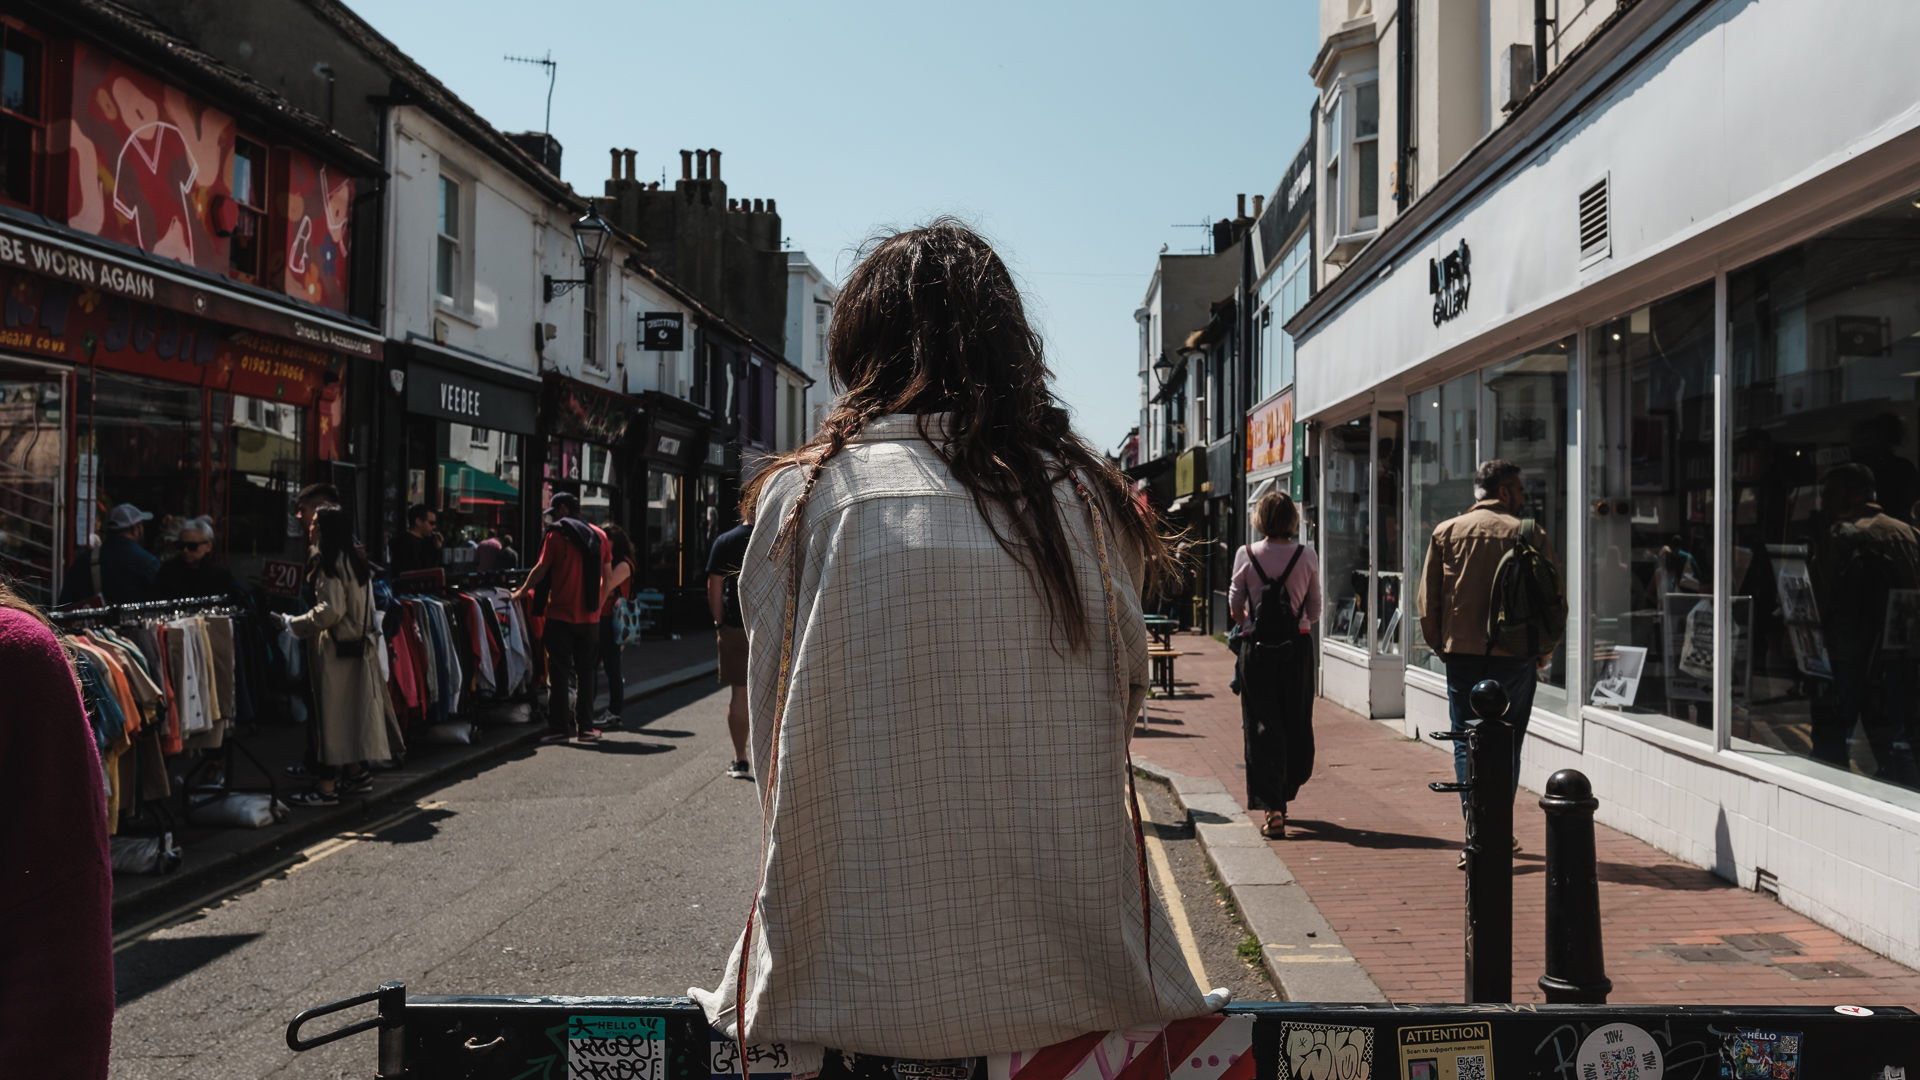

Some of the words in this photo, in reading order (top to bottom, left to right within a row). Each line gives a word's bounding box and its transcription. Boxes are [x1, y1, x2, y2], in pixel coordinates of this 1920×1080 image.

[0, 235, 26, 265] BE
[30, 244, 95, 283] WORN
[100, 264, 155, 300] AGAIN
[1433, 283, 1471, 329] GALLERY
[294, 321, 320, 341] Shoes
[330, 331, 372, 354] Accessories
[241, 355, 272, 376] 01903
[273, 361, 305, 382] 210066
[440, 382, 480, 417] VEEBEE
[268, 564, 297, 588] £20
[597, 1021, 637, 1030] HELLO
[1406, 1026, 1485, 1043] ATTENTION
[1747, 1031, 1778, 1041] HELLO
[1429, 1046, 1453, 1055] support
